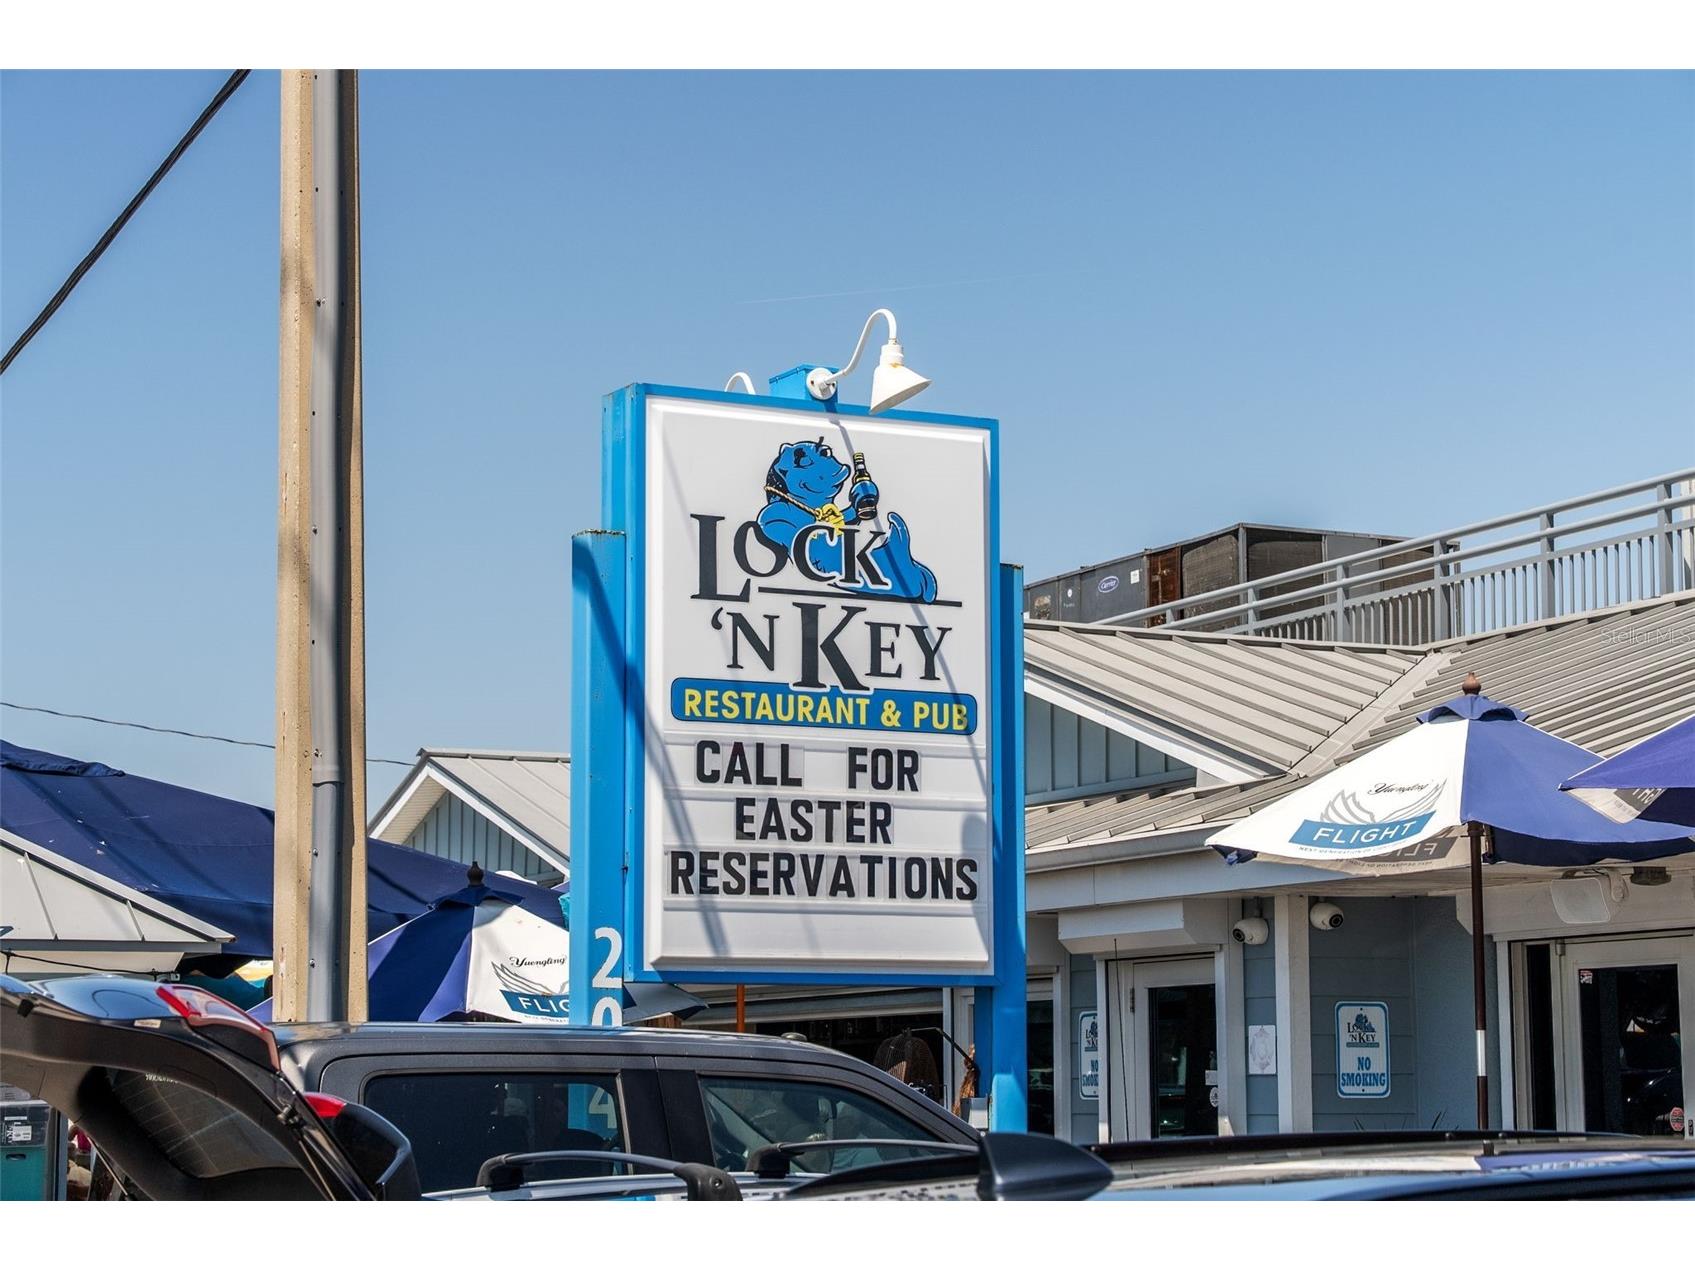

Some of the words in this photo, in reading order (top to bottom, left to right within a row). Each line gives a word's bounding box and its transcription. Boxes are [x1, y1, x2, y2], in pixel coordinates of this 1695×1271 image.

[690, 513, 890, 603] LOCK
[792, 602, 952, 691] KEY
[684, 688, 870, 727] RESTAURANT
[881, 699, 901, 728] &
[913, 701, 968, 731] PUB
[696, 740, 803, 787] CALL
[848, 747, 919, 792] FOR
[735, 797, 892, 844] EASTER
[1312, 820, 1417, 844] FLIGHT
[670, 851, 978, 900] RESERVATIONS
[1341, 1073, 1386, 1087] SMOKING
[1357, 1057, 1371, 1071] NO
